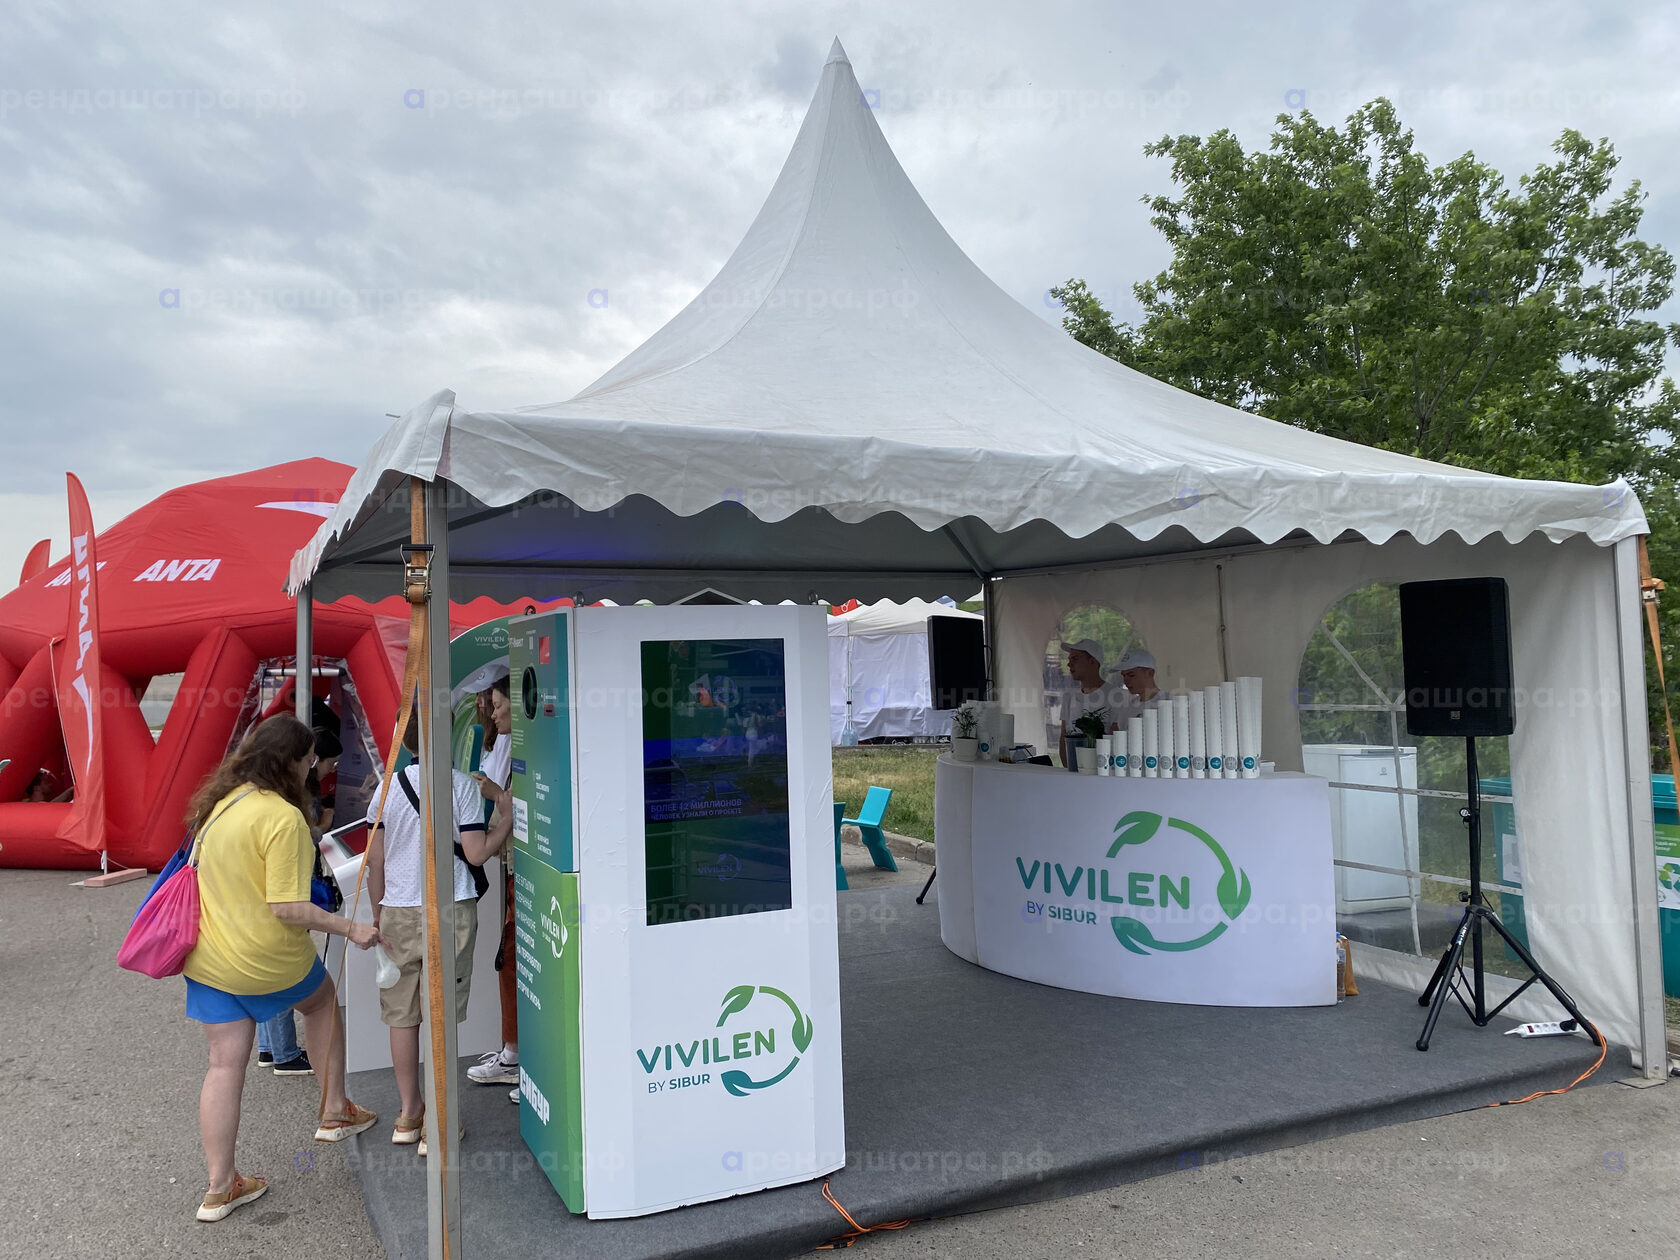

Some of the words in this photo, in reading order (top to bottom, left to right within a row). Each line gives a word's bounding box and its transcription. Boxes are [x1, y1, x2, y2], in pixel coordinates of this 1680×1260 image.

[133, 559, 221, 581] ANTA
[690, 799, 741, 809] МИЛЛИОНОВ
[714, 807, 742, 816] ПРОЕКТЕ
[1016, 856, 1190, 910] VIVILEN
[1026, 901, 1044, 915] BY
[1048, 906, 1097, 925] SIBUR
[540, 912, 560, 940] VIVILEN
[636, 1027, 775, 1075] VIVILEN
[648, 1080, 665, 1093] BY
[669, 1073, 711, 1090] SIBUR
[519, 1066, 550, 1126] СИБУР
